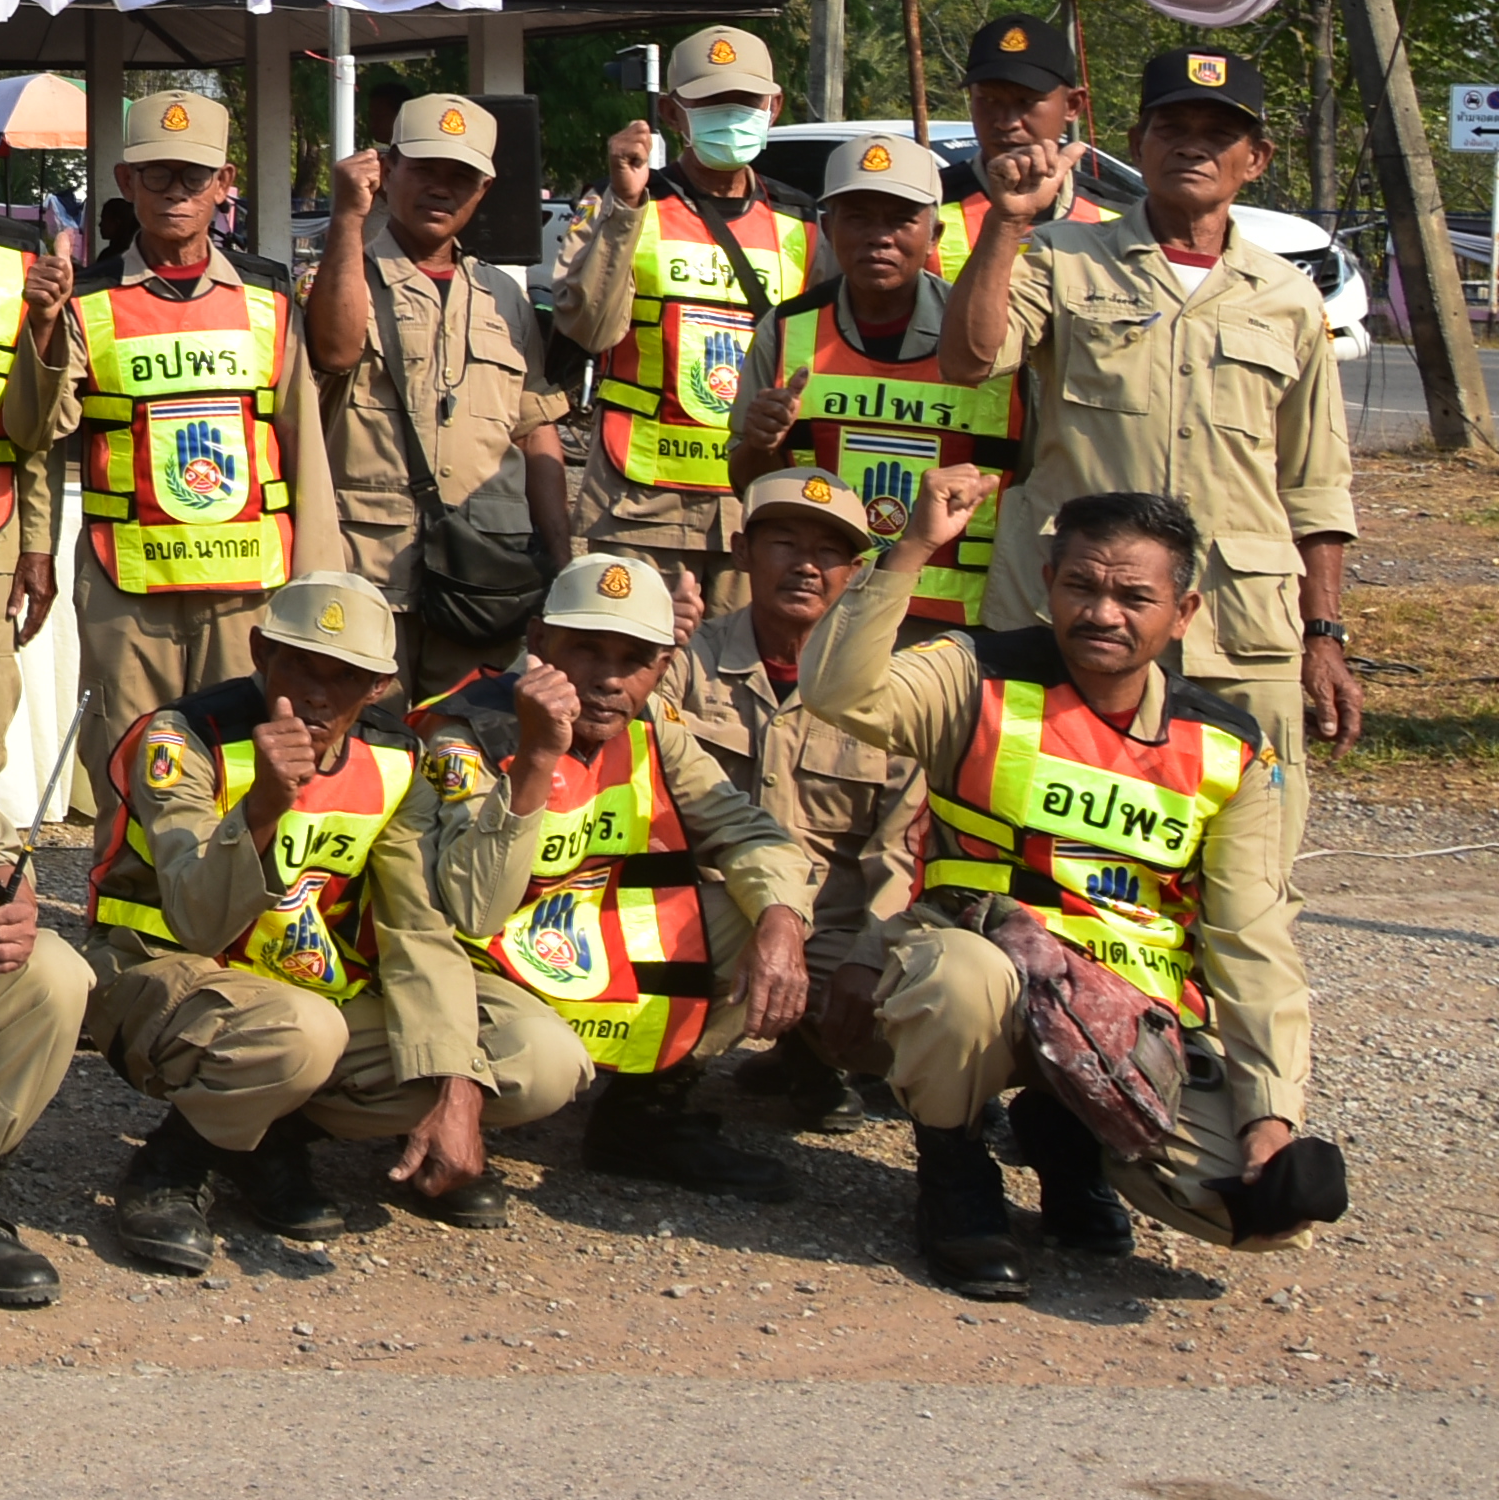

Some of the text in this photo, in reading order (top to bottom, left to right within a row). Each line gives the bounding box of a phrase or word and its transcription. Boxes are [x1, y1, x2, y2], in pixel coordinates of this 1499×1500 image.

[130, 340, 248, 382] อปพร.
[823, 382, 970, 431] อปพร.
[144, 537, 261, 562] อบต.นากอก
